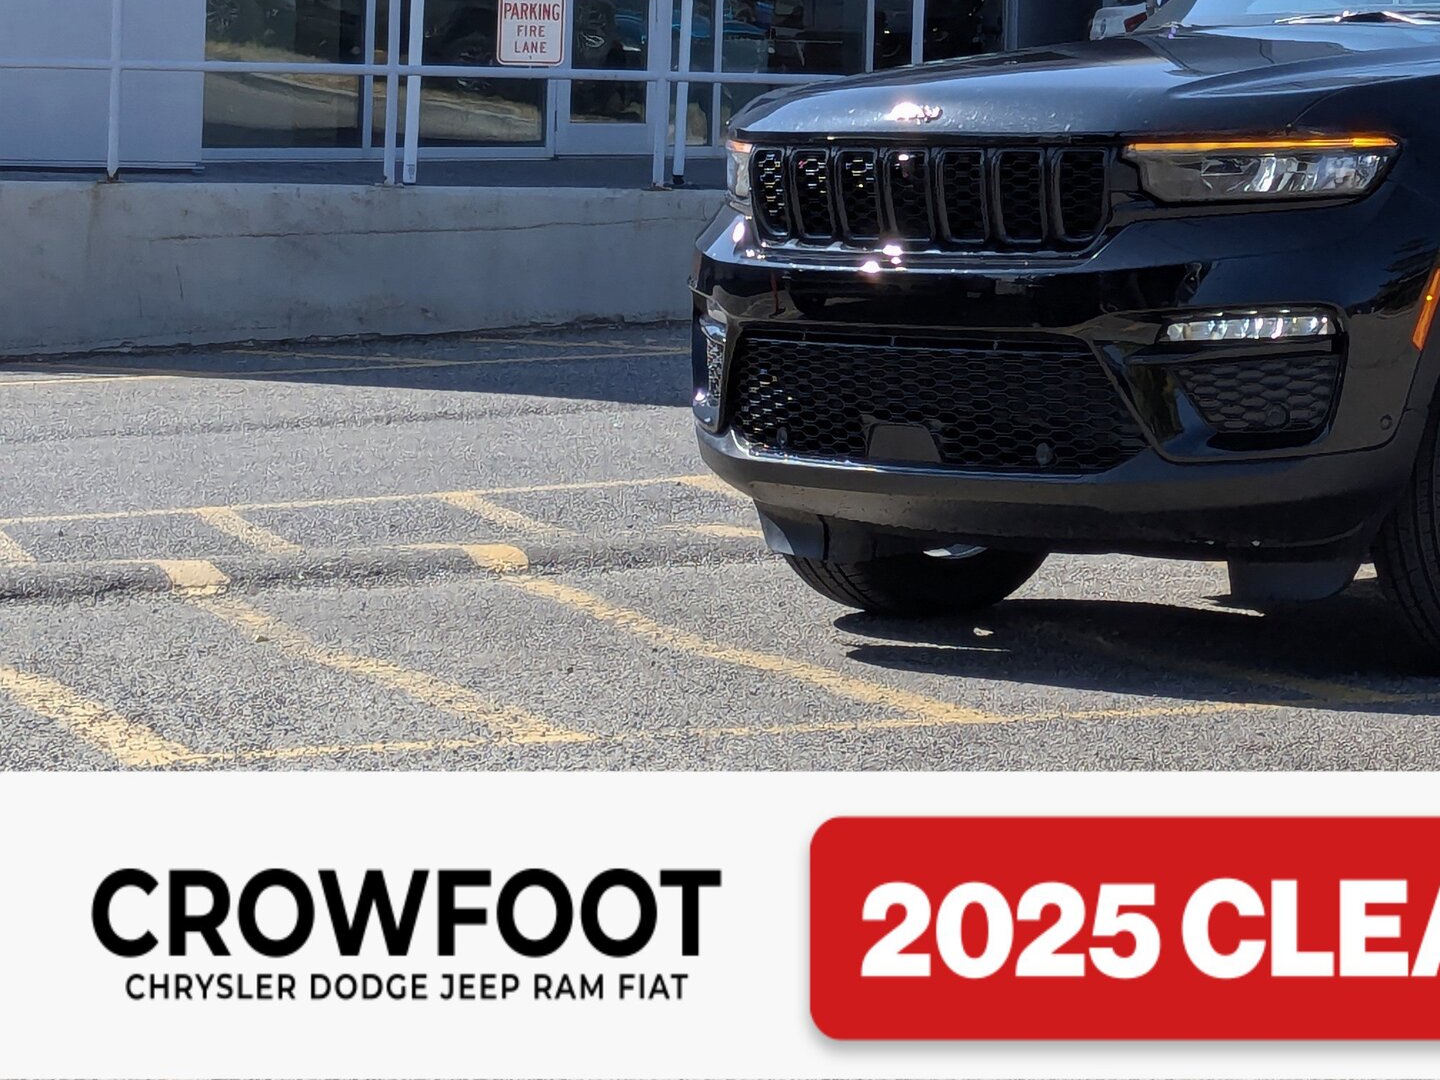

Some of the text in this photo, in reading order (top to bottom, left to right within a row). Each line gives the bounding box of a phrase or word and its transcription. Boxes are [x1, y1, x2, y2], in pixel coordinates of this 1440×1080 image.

[504, 2, 560, 21] PARKING
[517, 25, 545, 38] FIRE
[514, 41, 547, 54] LANE
